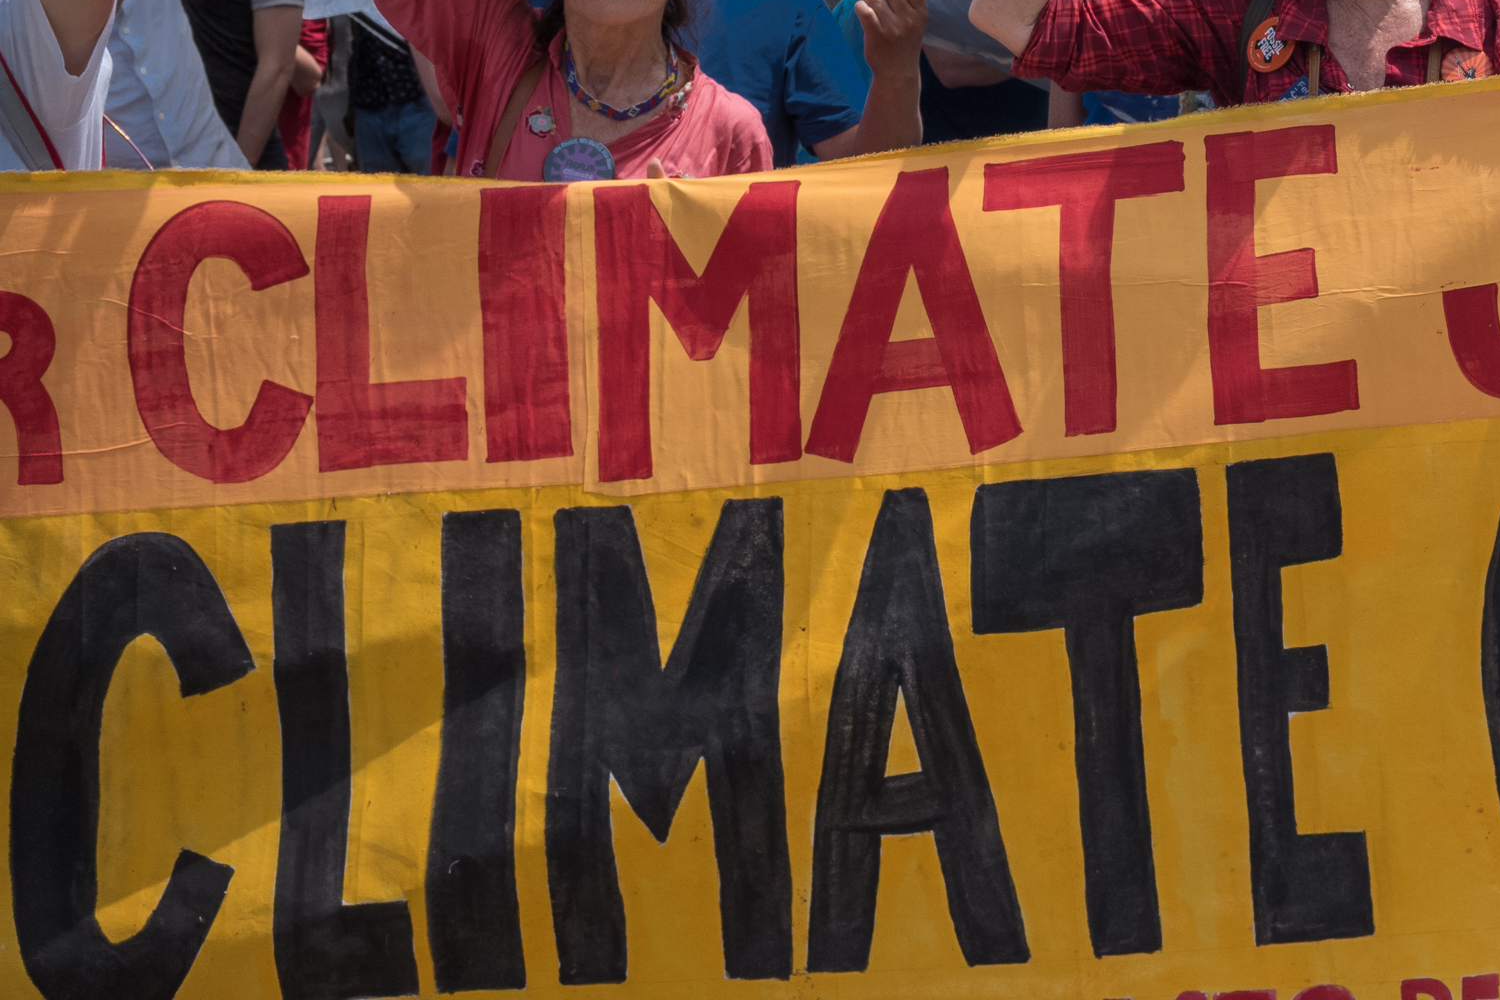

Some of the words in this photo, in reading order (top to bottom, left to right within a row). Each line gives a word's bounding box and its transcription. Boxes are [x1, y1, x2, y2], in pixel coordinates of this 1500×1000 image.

[1257, 37, 1275, 61] FREE
[1264, 26, 1284, 56] FOSSIL
[127, 123, 1360, 484] CLIMATE
[9, 451, 1374, 1000] CLIMATE
